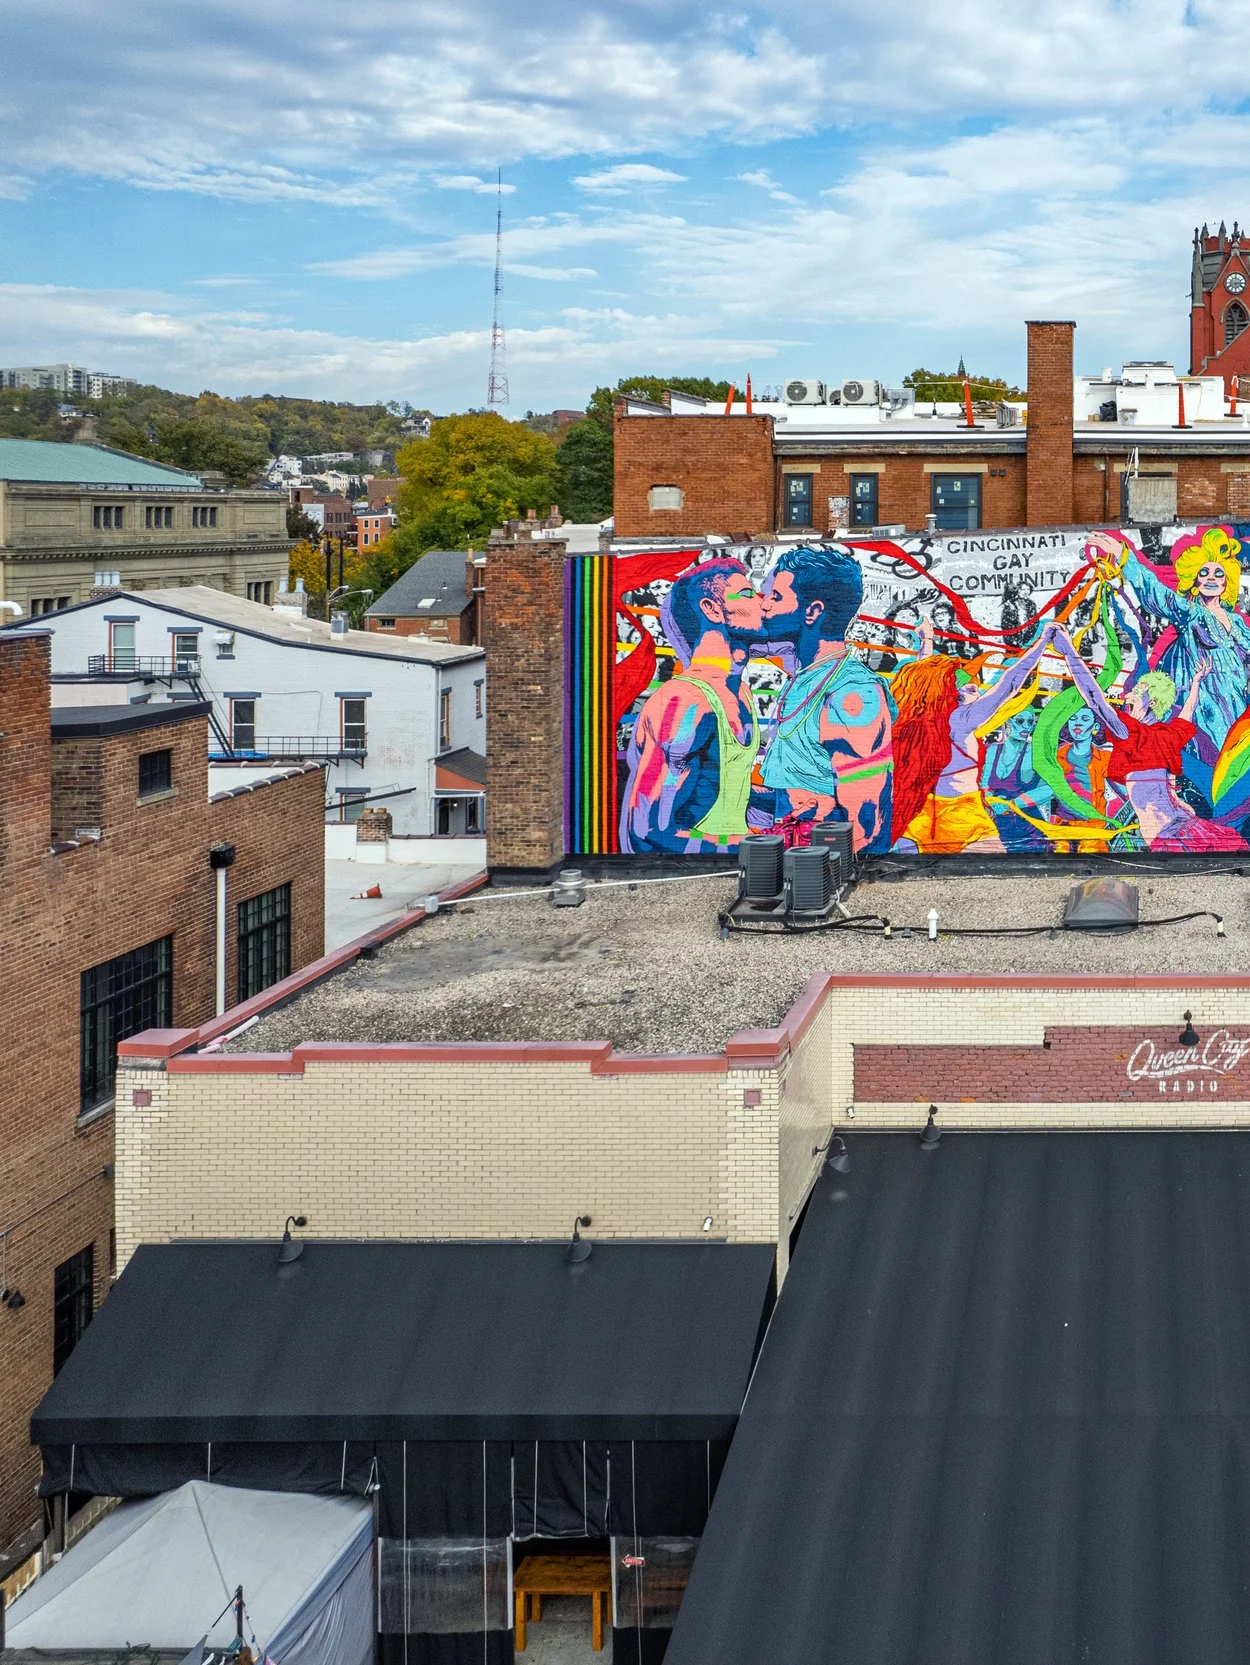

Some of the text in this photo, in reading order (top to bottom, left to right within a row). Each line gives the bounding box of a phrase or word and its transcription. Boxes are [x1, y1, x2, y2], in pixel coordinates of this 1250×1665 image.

[947, 534, 1066, 554] CINCINNATI
[993, 552, 1034, 571] GAY
[1126, 1028, 1250, 1081] Queen City
[1158, 1080, 1219, 1093] RADIO
